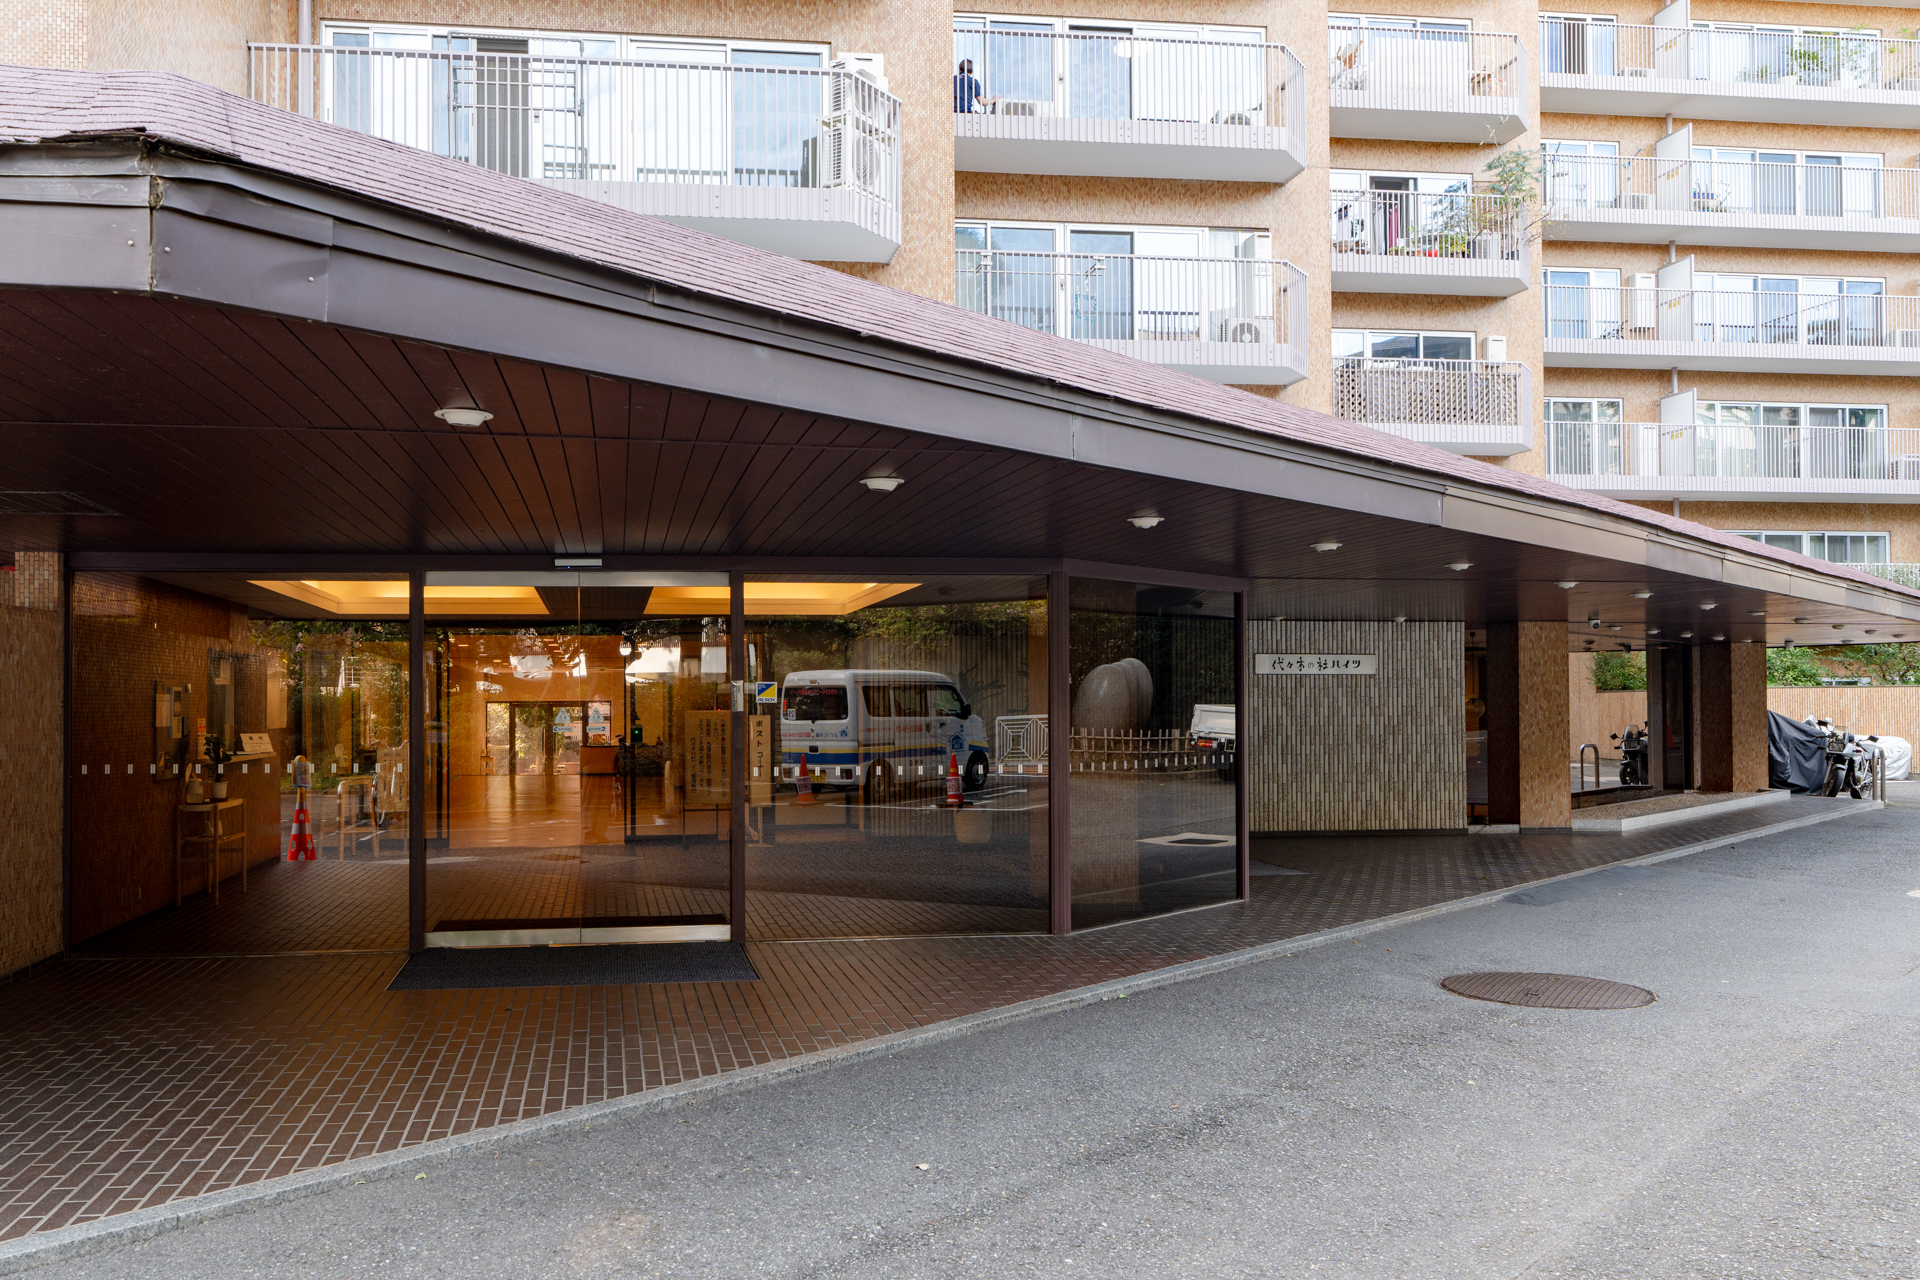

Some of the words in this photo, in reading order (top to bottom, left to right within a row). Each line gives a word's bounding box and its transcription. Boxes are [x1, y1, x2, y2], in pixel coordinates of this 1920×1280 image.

[756, 720, 764, 777] ポストコーナー
